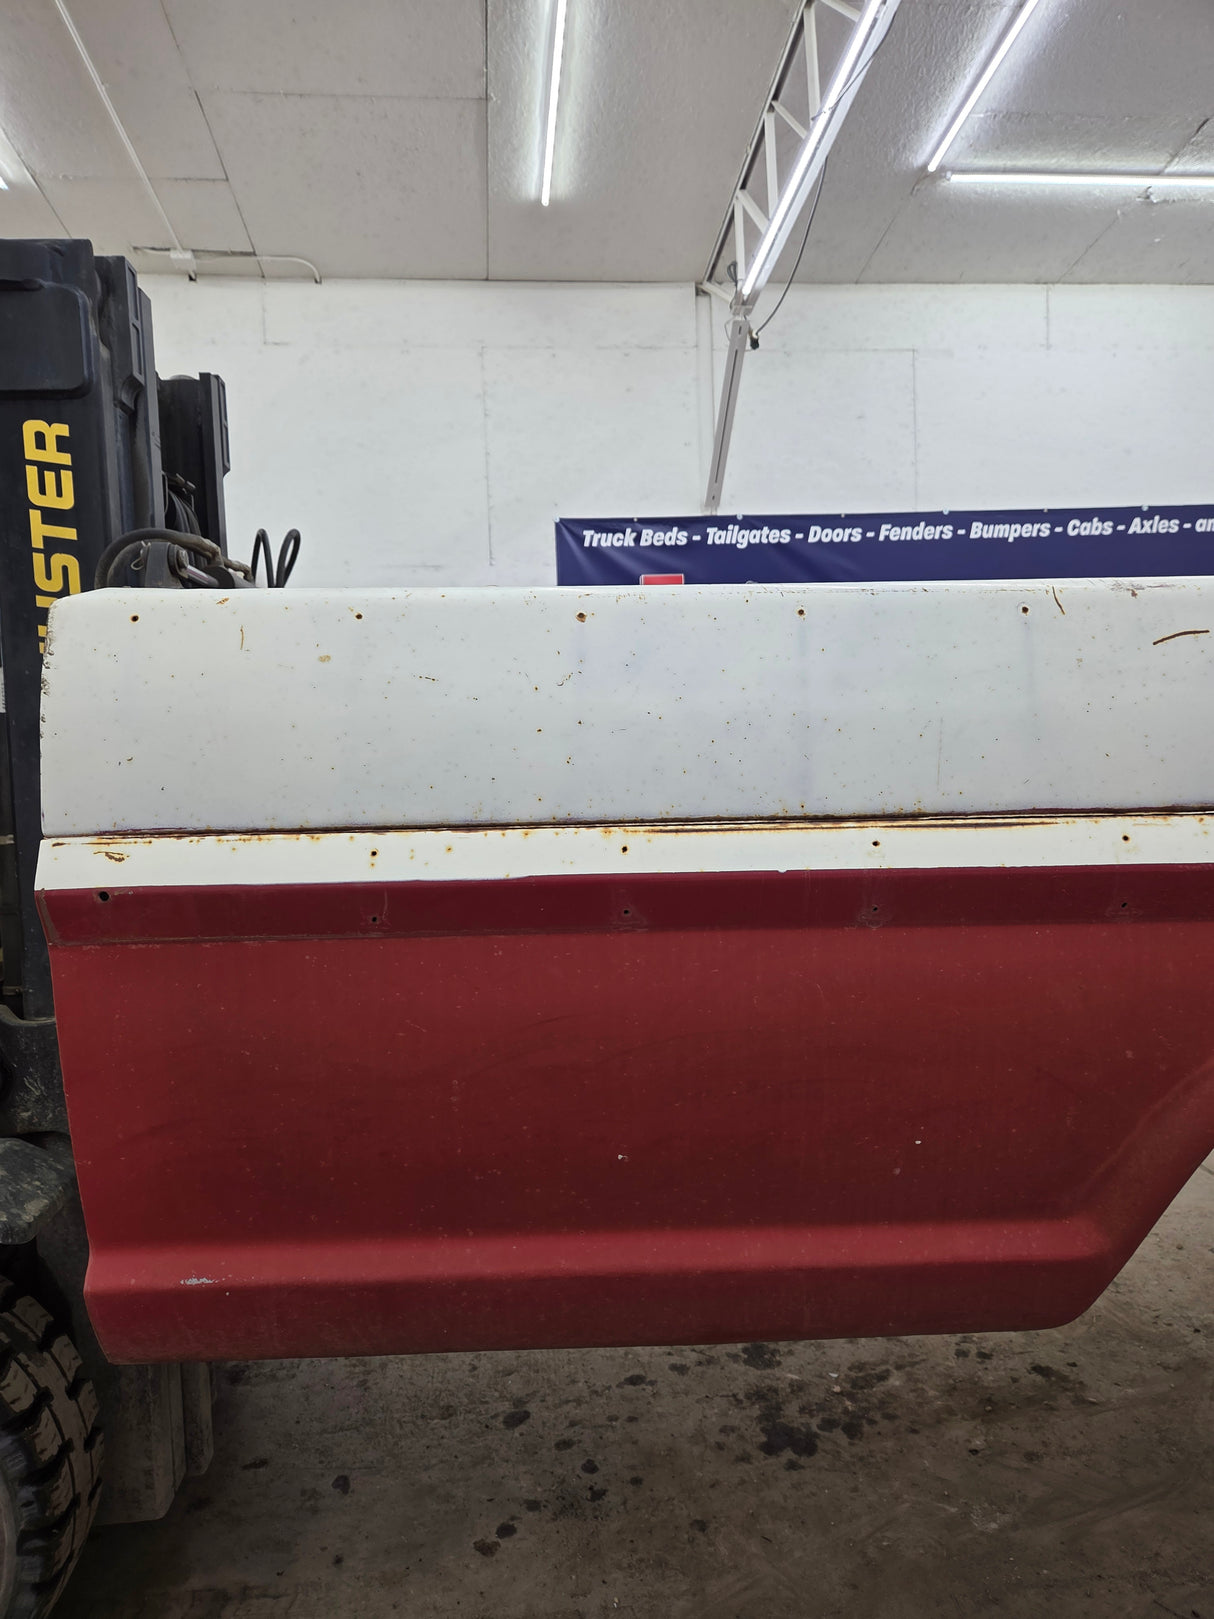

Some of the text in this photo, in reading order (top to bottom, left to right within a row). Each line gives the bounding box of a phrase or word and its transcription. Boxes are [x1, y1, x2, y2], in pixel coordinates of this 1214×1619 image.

[22, 419, 81, 654] STER
[582, 528, 636, 548] Truck
[639, 526, 689, 547] Beds
[706, 524, 792, 549] Tailgates
[807, 526, 863, 544] Doors
[878, 521, 954, 542] Fenders
[969, 521, 1052, 543] Bumpers
[1066, 516, 1114, 537] Cabs
[1127, 514, 1180, 535] Axles
